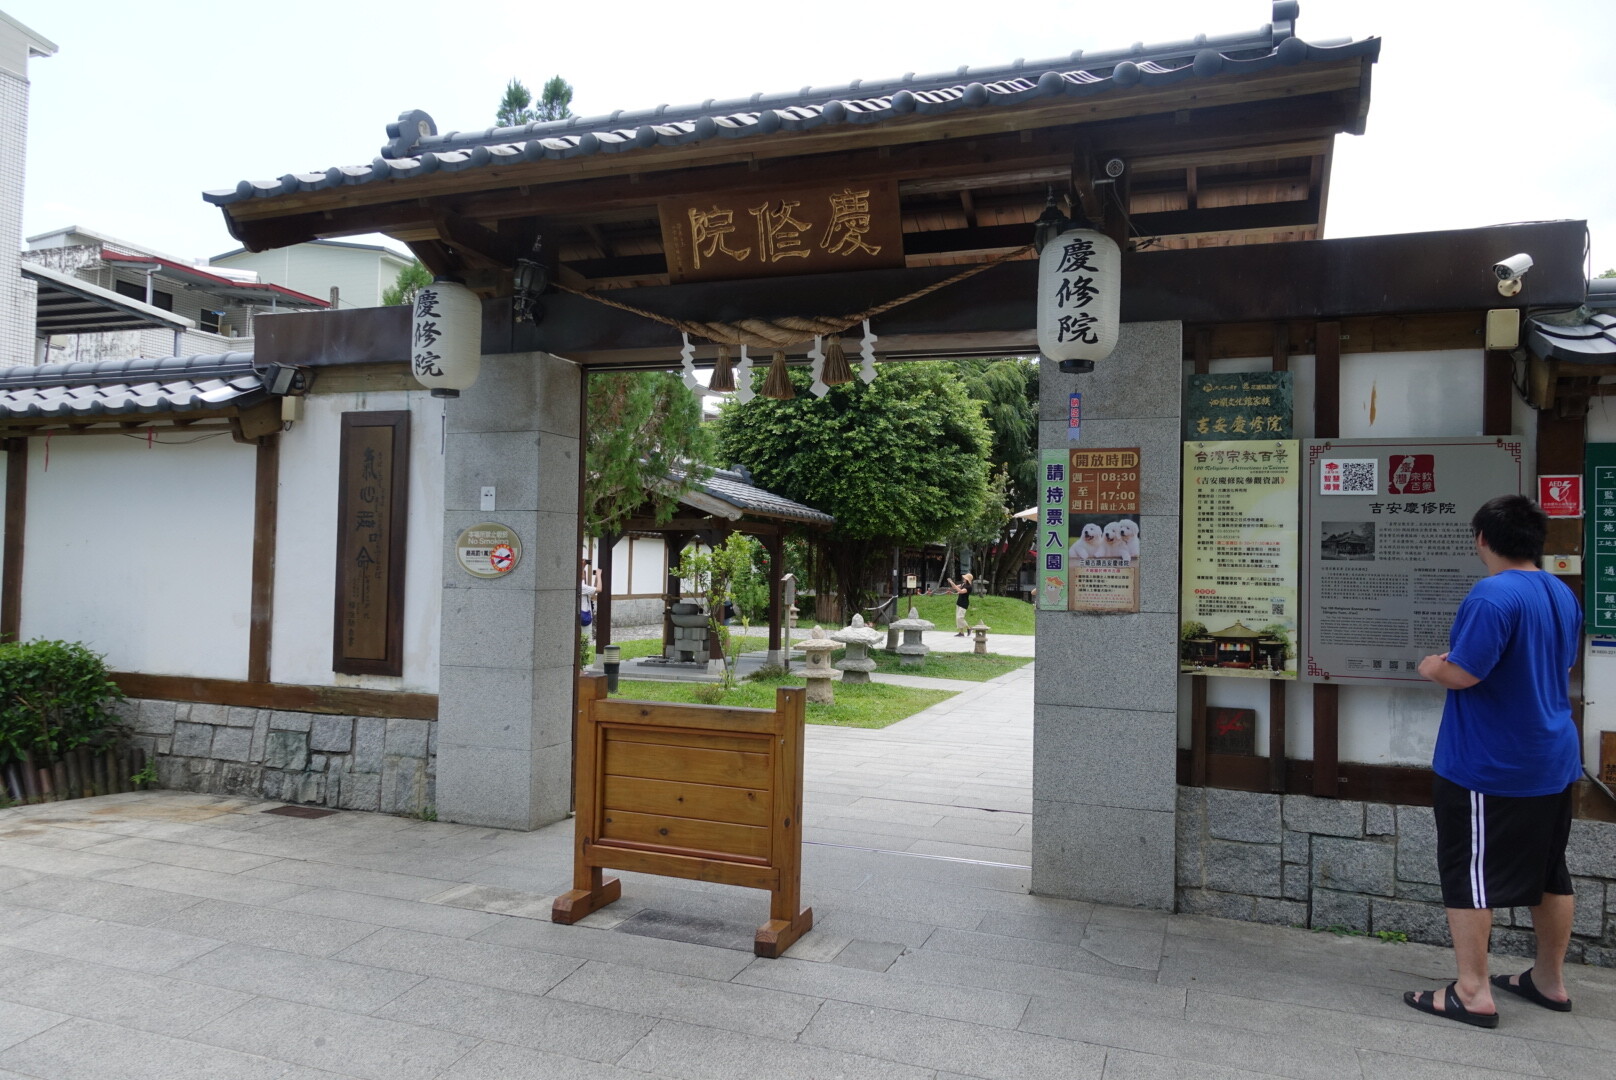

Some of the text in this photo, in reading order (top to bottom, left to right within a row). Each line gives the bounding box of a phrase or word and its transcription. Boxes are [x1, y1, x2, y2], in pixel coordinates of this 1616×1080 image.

[1055, 238, 1099, 344] 慶修院
[414, 289, 444, 377] 慶修院
[1196, 415, 1283, 434] 吉安慶修院
[1075, 453, 1136, 468] 開放時間
[1194, 449, 1288, 465] 台灣宗教百景
[1072, 472, 1095, 483] 週二
[1101, 472, 1136, 482] 08:30
[1077, 486, 1089, 497] 至
[1101, 491, 1136, 500] 17:00
[1072, 500, 1094, 511] 週日
[1368, 501, 1456, 515] 吉安慶修院
[1046, 463, 1064, 571] 請持票入園
[479, 537, 508, 545] Smoking
